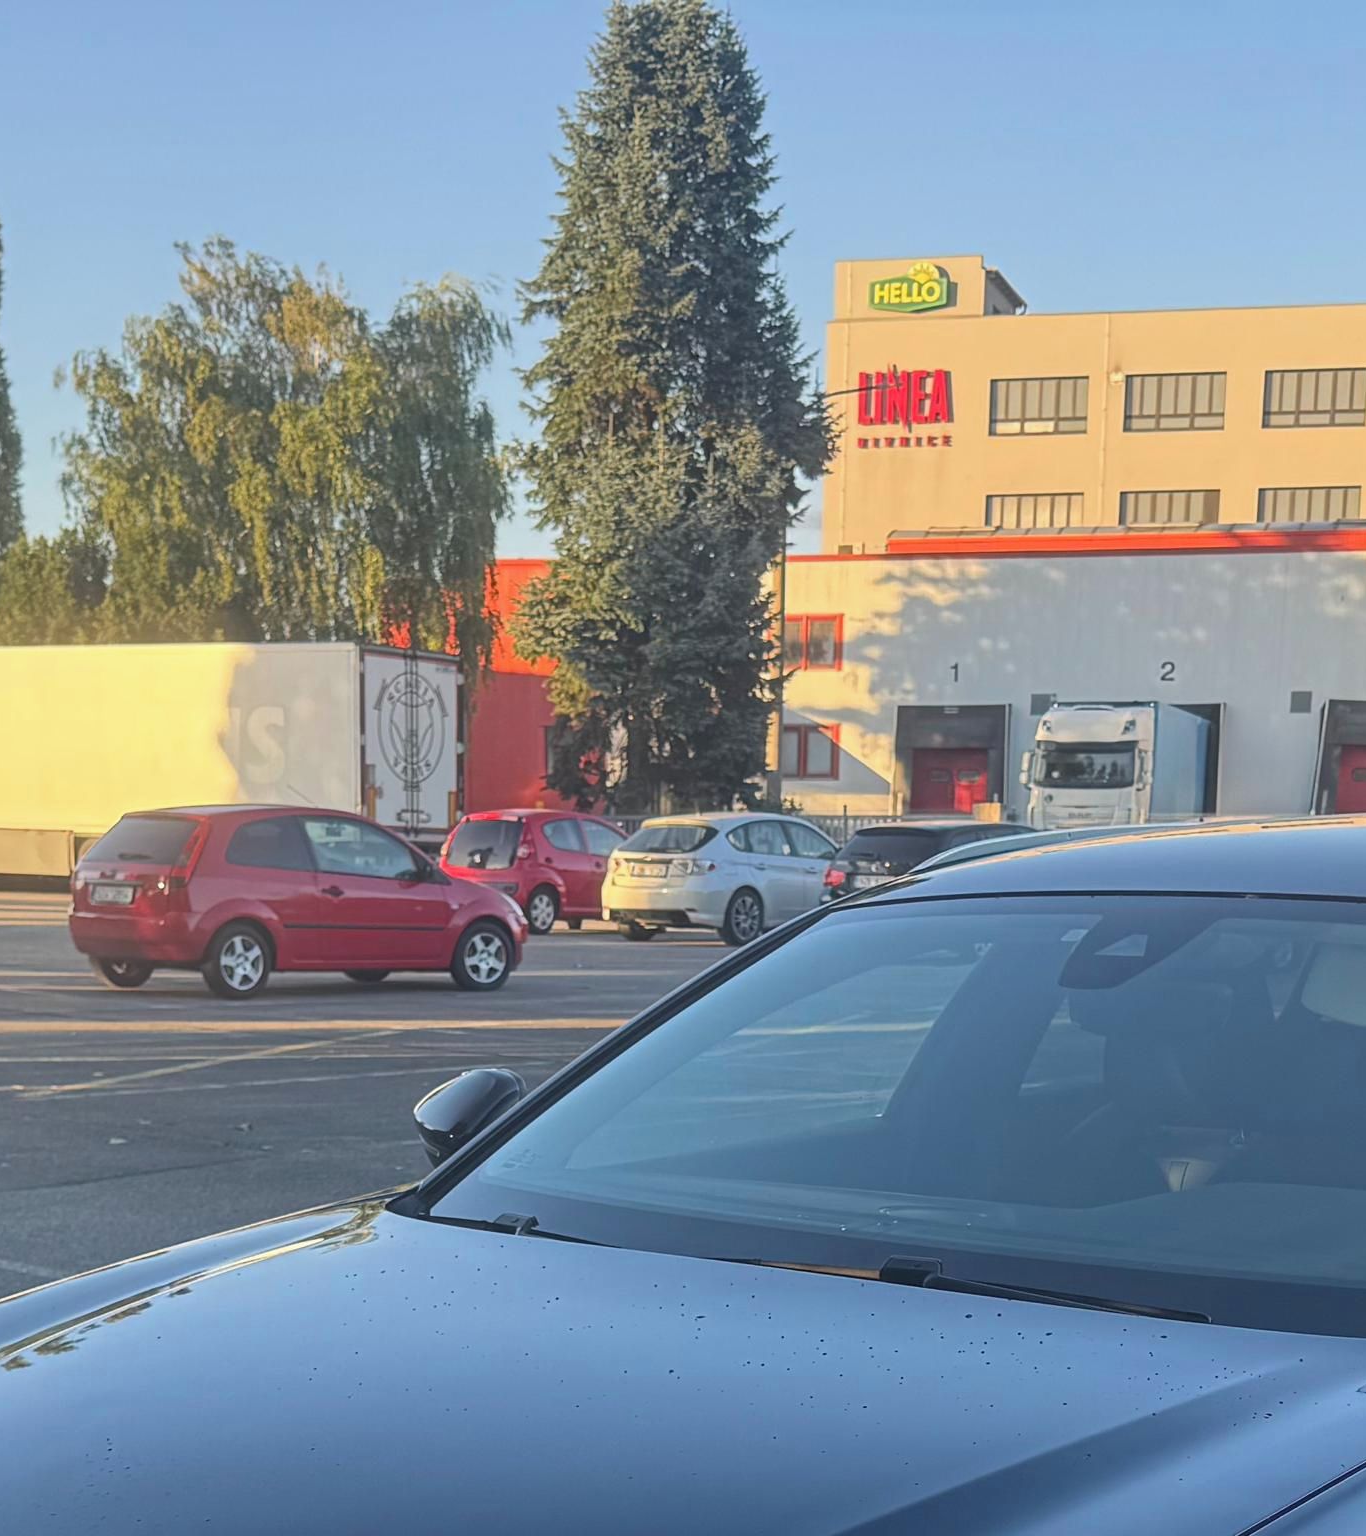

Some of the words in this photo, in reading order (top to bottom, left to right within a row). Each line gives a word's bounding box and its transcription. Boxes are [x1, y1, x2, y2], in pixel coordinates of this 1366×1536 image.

[874, 281, 941, 304] HELLO
[857, 364, 951, 430] LINEA
[949, 662, 961, 683] 1
[1160, 661, 1176, 682] 2
